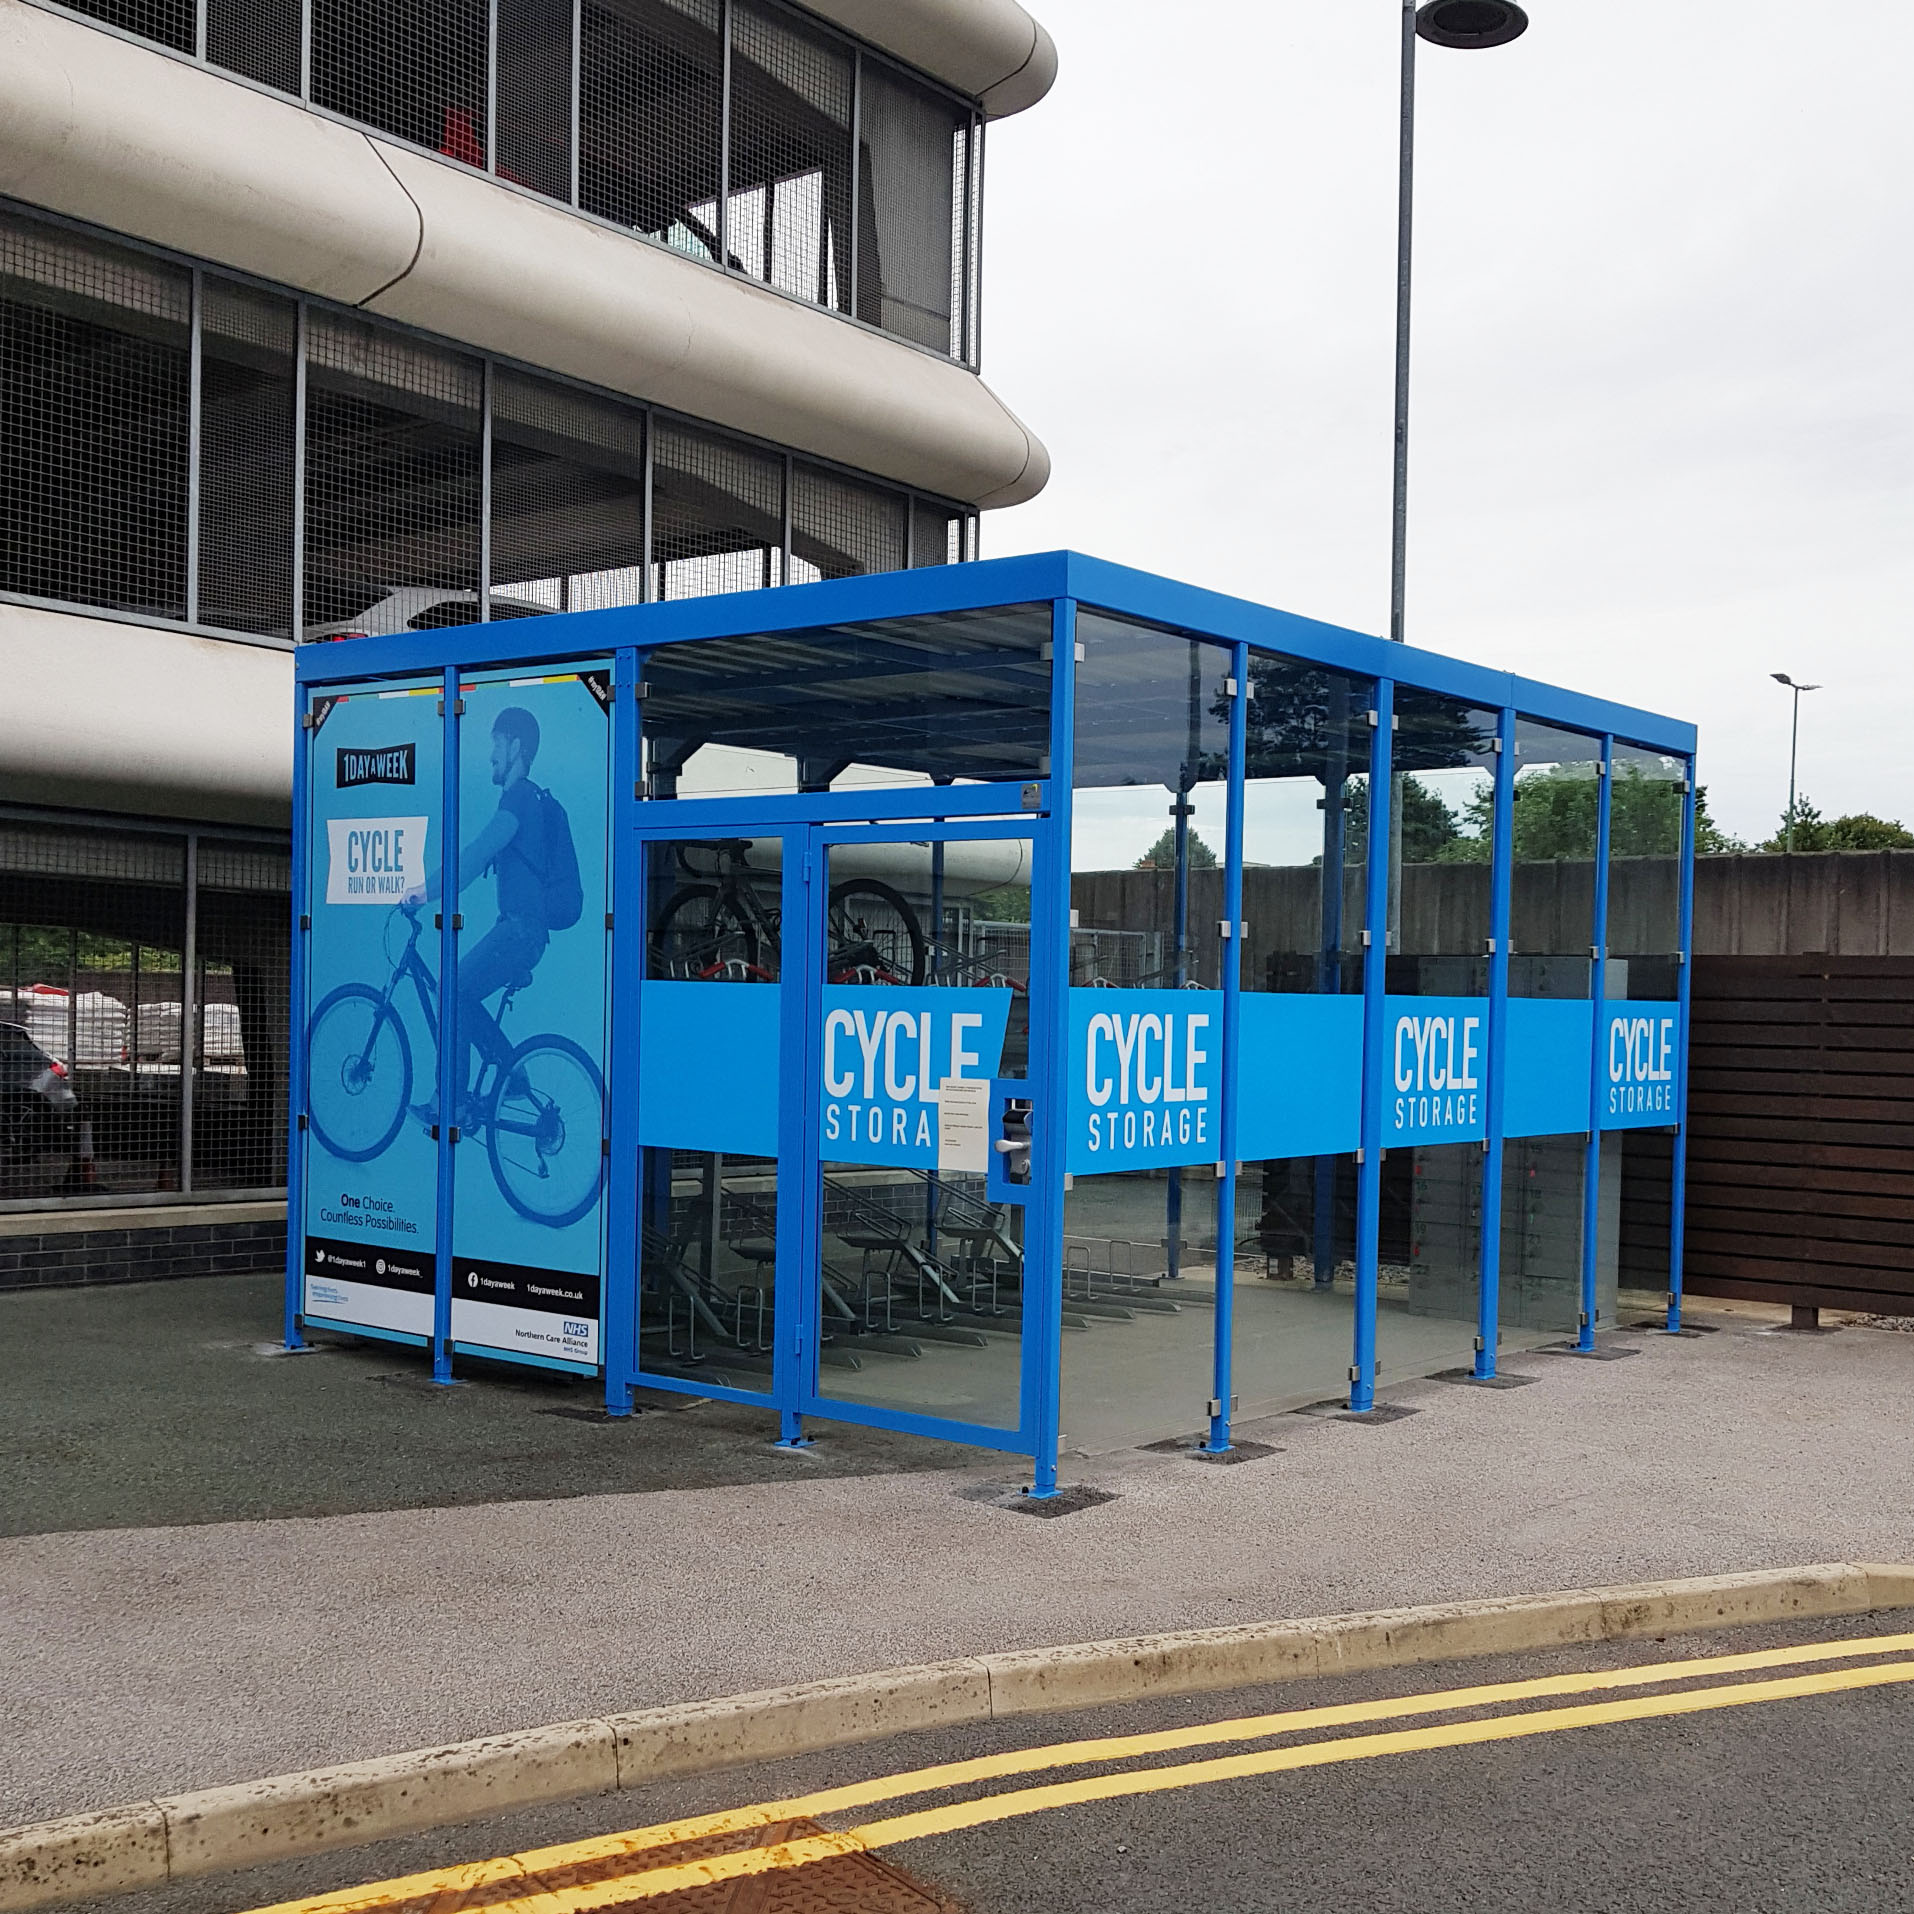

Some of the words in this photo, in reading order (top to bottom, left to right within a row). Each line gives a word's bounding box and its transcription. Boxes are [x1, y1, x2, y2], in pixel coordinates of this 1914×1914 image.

[348, 829, 404, 873] CYCLE
[348, 876, 364, 894] RUN
[365, 876, 376, 894] OR
[377, 876, 405, 894] WALK?
[824, 1008, 984, 1103] CYCLE
[1086, 1013, 1210, 1107] CYCLE
[1394, 1016, 1480, 1093] CYCLE
[1608, 1017, 1674, 1083] CYCLE
[1395, 1093, 1478, 1130] STORAGE
[1609, 1084, 1672, 1114] STORAGE
[826, 1103, 932, 1148] STORA
[1088, 1106, 1208, 1152] STORAGE
[320, 1208, 364, 1227] Countless
[365, 1214, 420, 1234] Possibilities.
[341, 1193, 361, 1209] One
[362, 1195, 396, 1213] Choice.
[480, 1277, 516, 1290] 1dayaweek
[526, 1284, 584, 1300] 1dayaweek.co.uk
[515, 1328, 545, 1341] Northern
[545, 1334, 561, 1344] Care
[562, 1337, 589, 1348] Alliance
[564, 1322, 588, 1336] NHS
